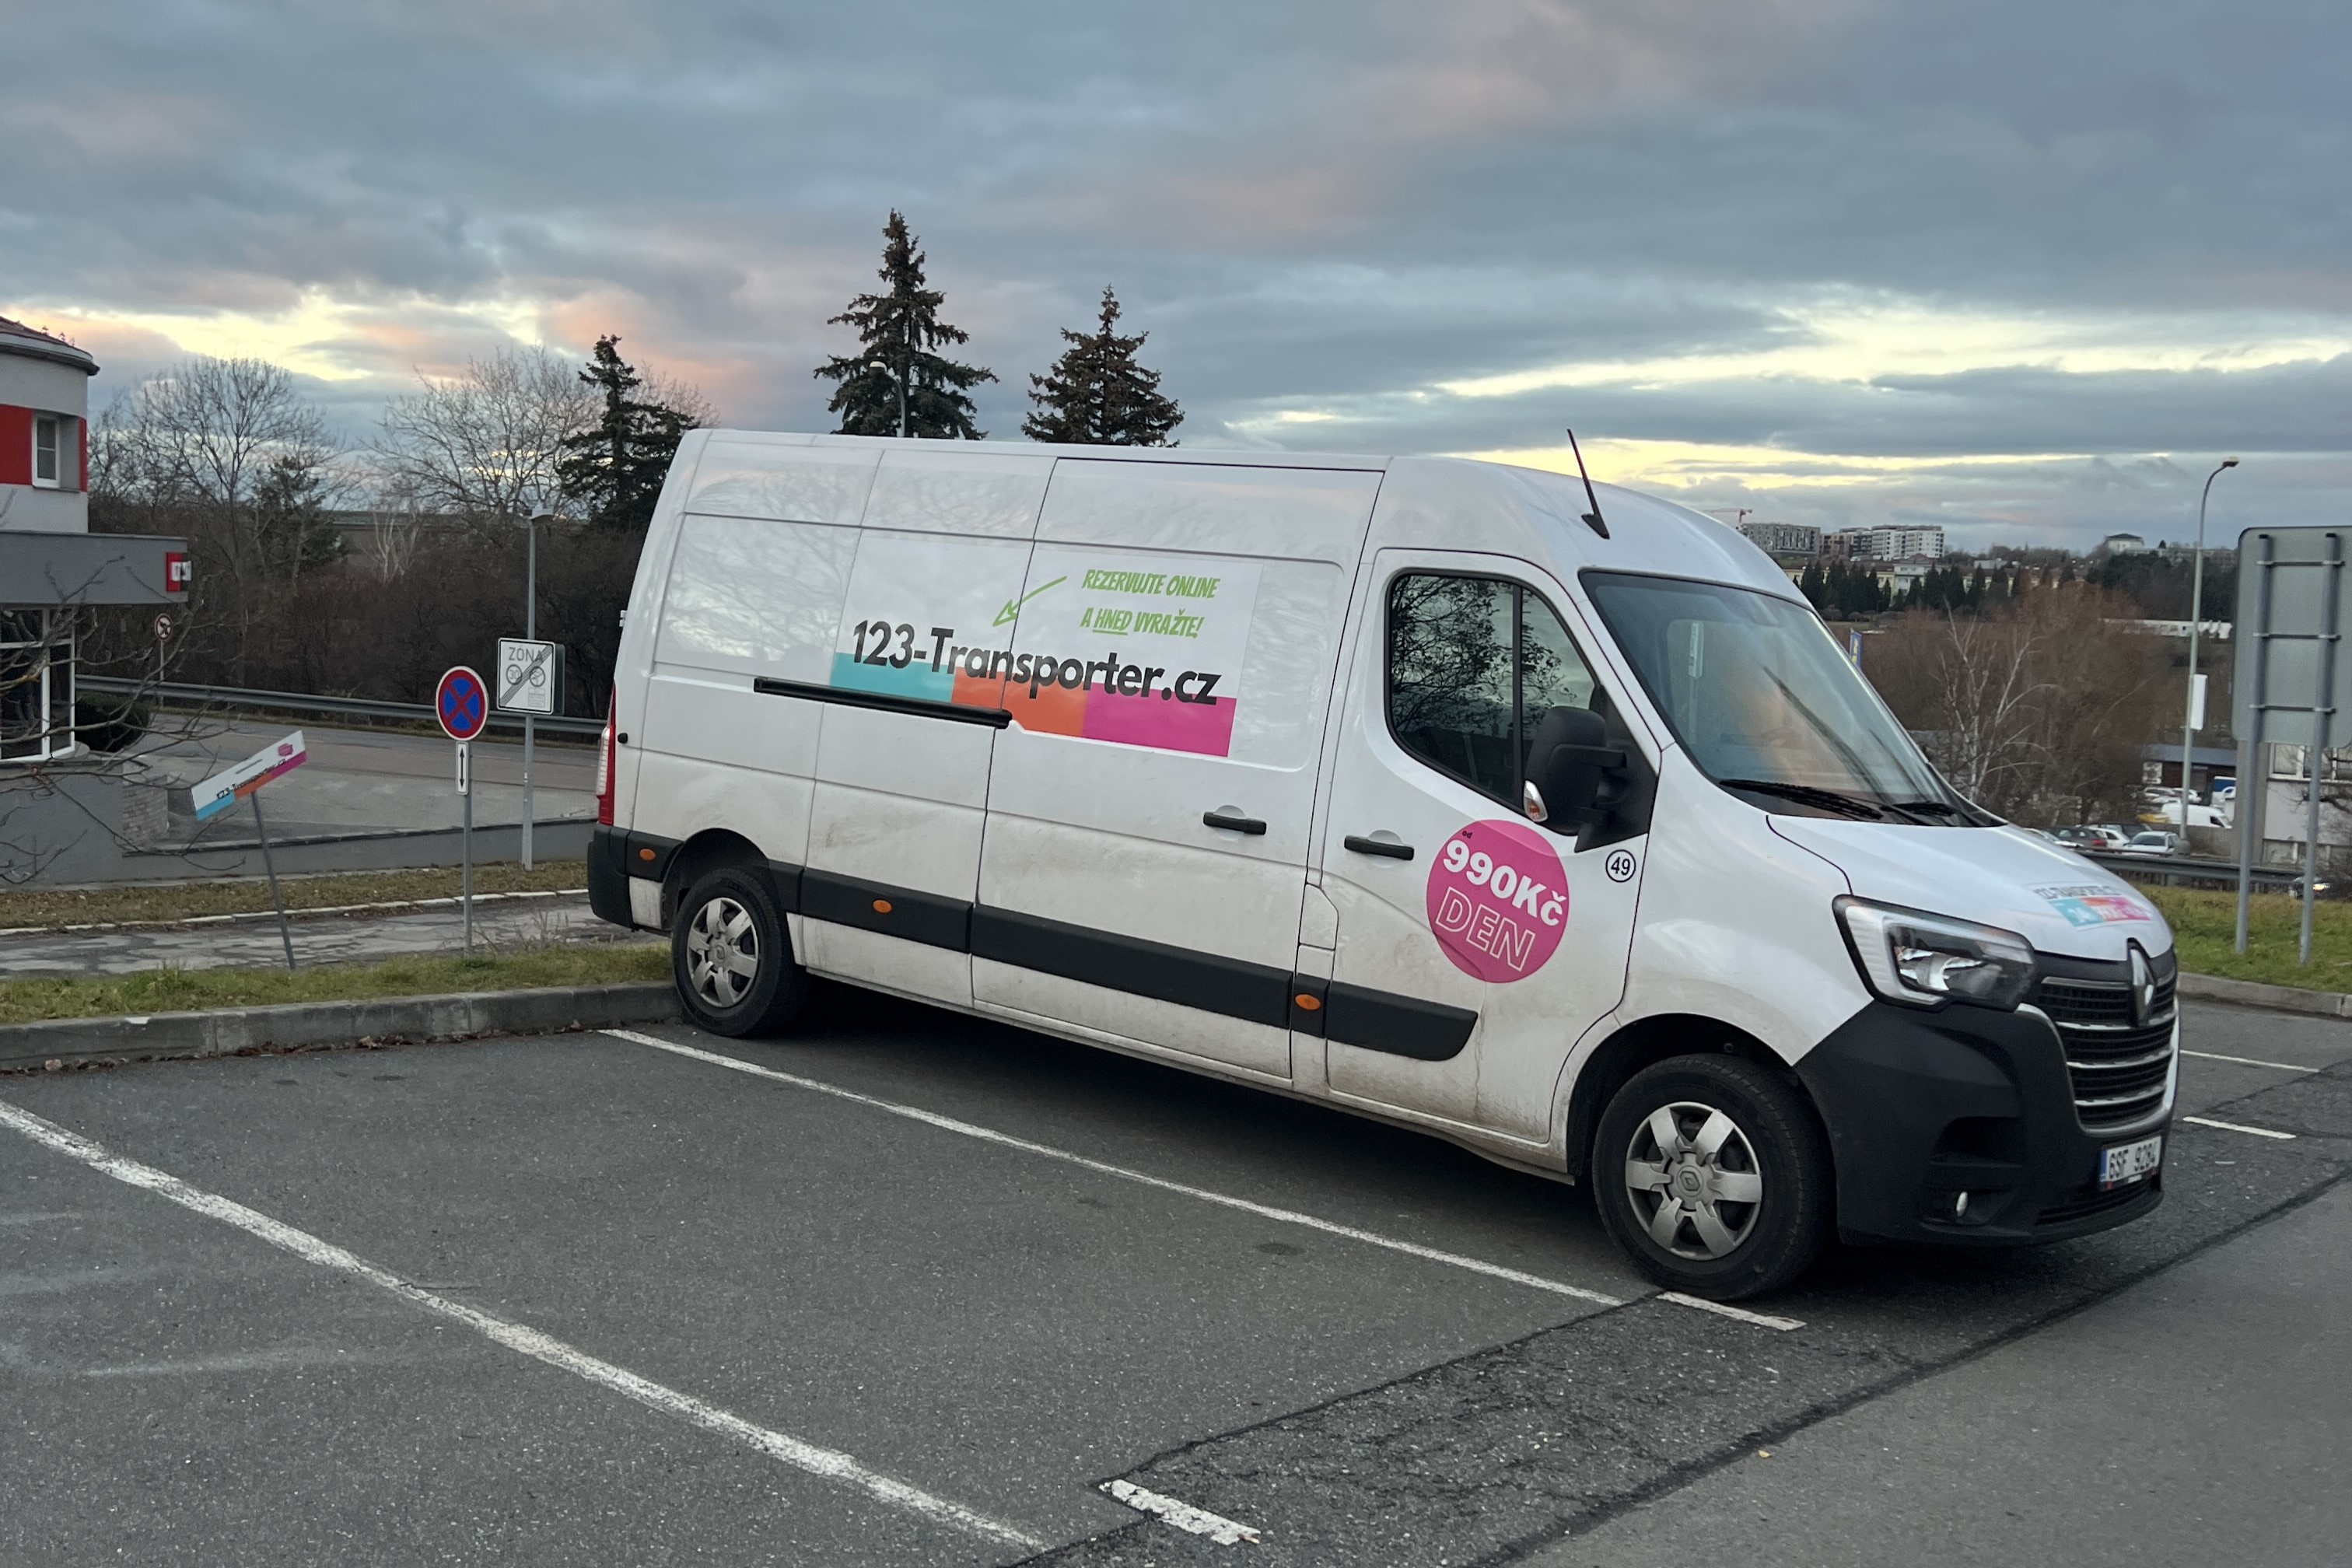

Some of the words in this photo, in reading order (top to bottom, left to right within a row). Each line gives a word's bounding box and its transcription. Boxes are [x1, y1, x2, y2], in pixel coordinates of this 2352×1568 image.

[1082, 569, 1167, 594] REZERVUJTE
[1166, 576, 1221, 598] ONLINE
[1080, 607, 1094, 627] A
[1094, 608, 1132, 632] HNED
[1134, 609, 1205, 639] VYRAŽTE!
[509, 646, 544, 662] ZÓNA
[853, 620, 1222, 705] 123-Transporter.cz
[509, 669, 520, 680] 30
[1461, 830, 1472, 839] od
[1611, 856, 1630, 876] 49
[1436, 887, 1535, 971] DEN
